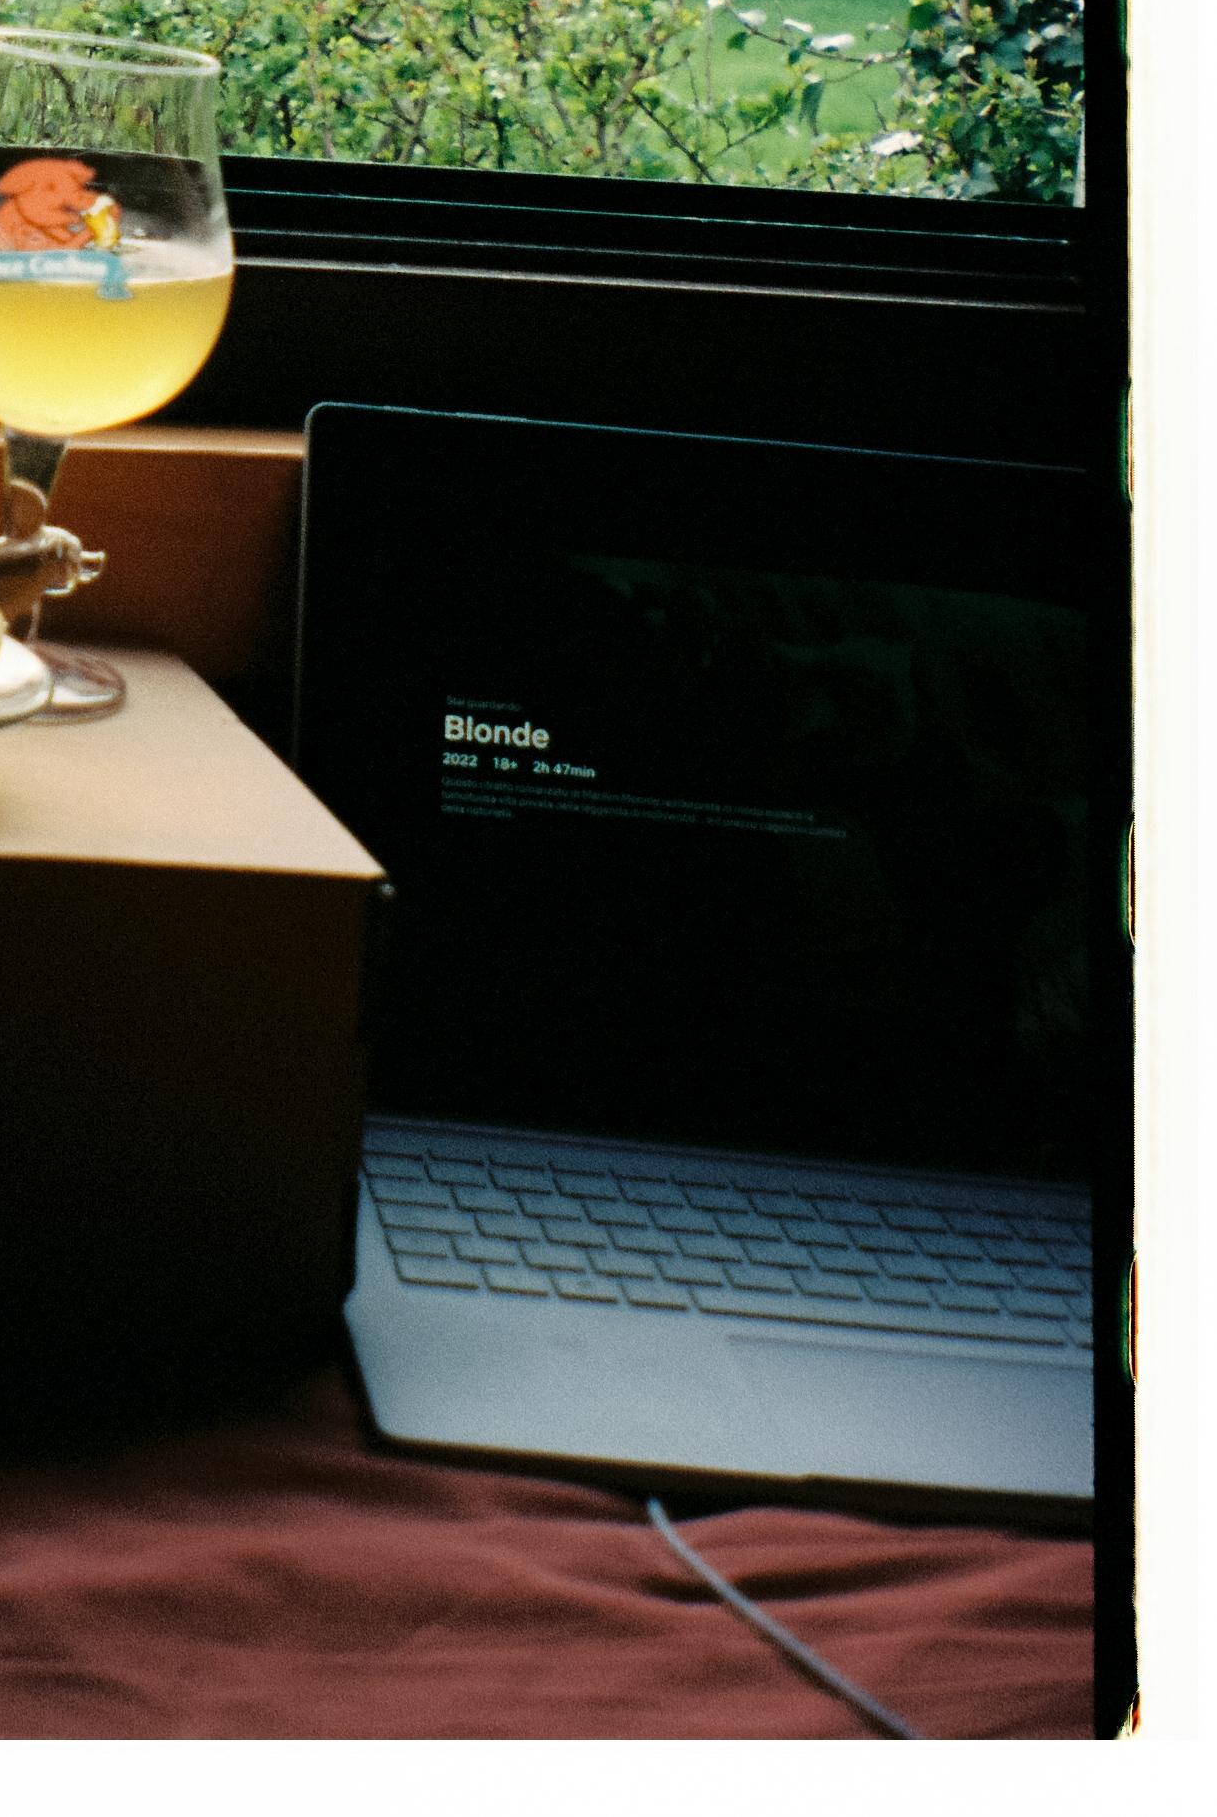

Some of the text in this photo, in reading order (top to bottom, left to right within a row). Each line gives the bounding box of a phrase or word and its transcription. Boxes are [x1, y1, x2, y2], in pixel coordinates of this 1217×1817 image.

[444, 714, 550, 749] Blonde
[442, 751, 478, 767] 2022
[533, 759, 550, 774] 2h
[553, 762, 596, 778] 47min
